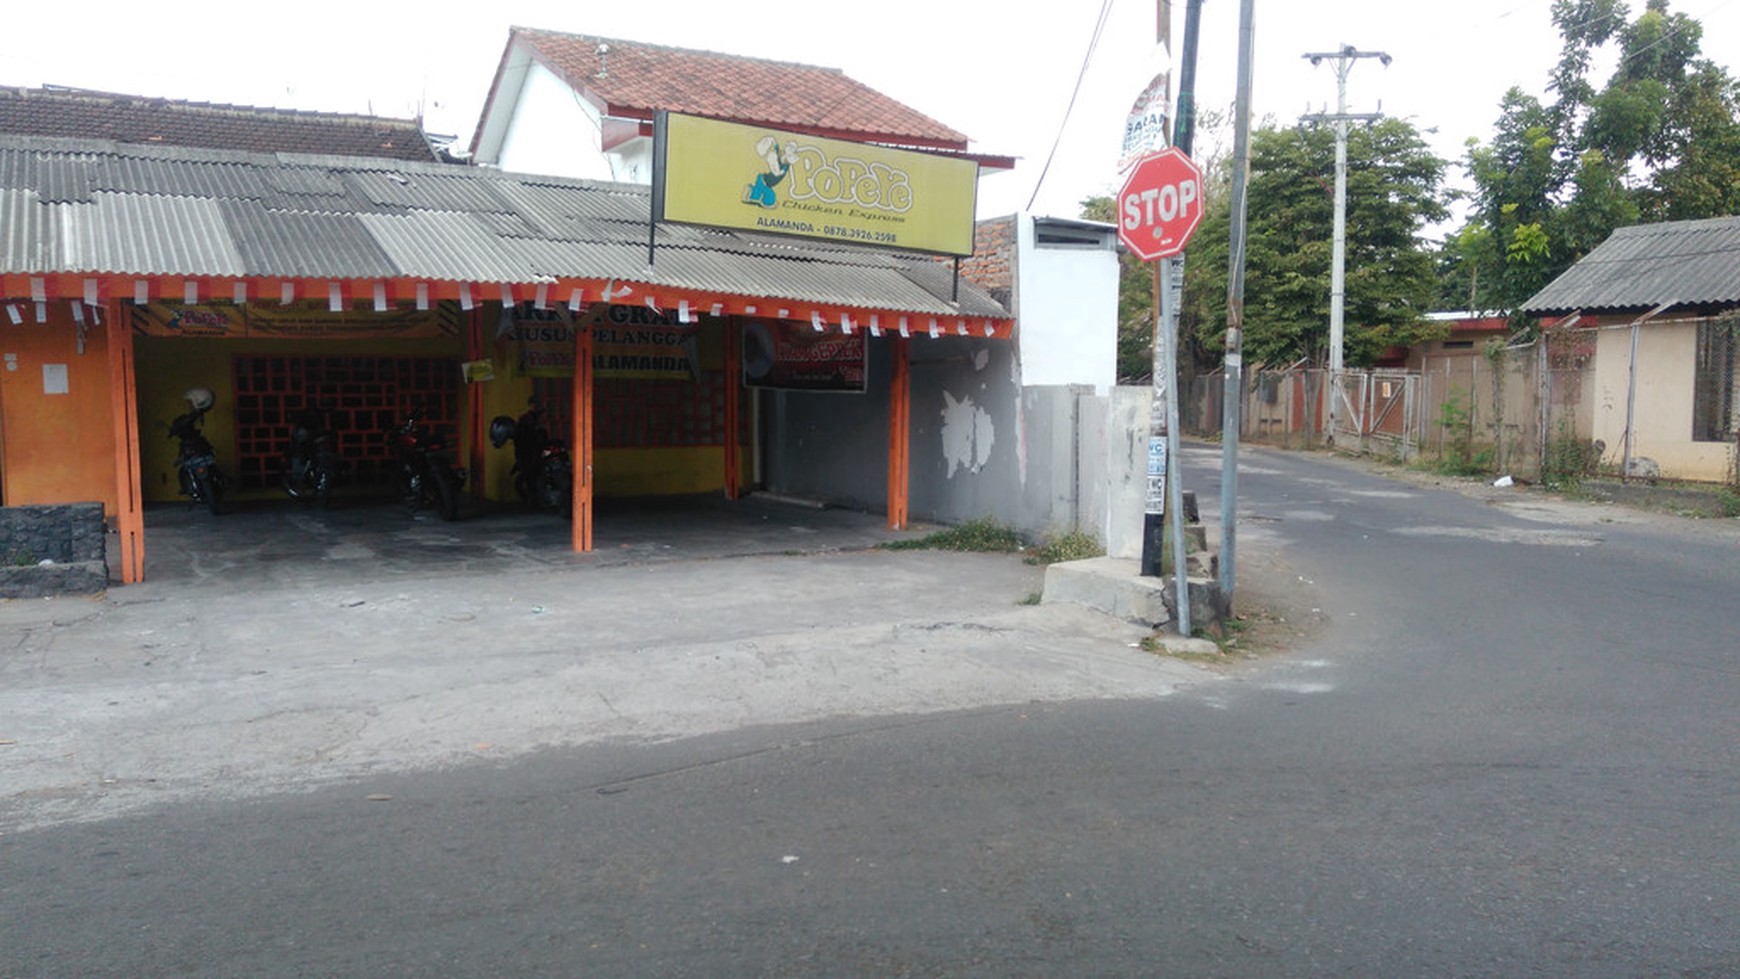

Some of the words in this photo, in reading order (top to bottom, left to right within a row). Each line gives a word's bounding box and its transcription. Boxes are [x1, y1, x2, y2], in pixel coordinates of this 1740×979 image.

[782, 201, 843, 216] Chicken
[1124, 179, 1197, 231] STOP
[757, 216, 814, 233] ALAMANDA
